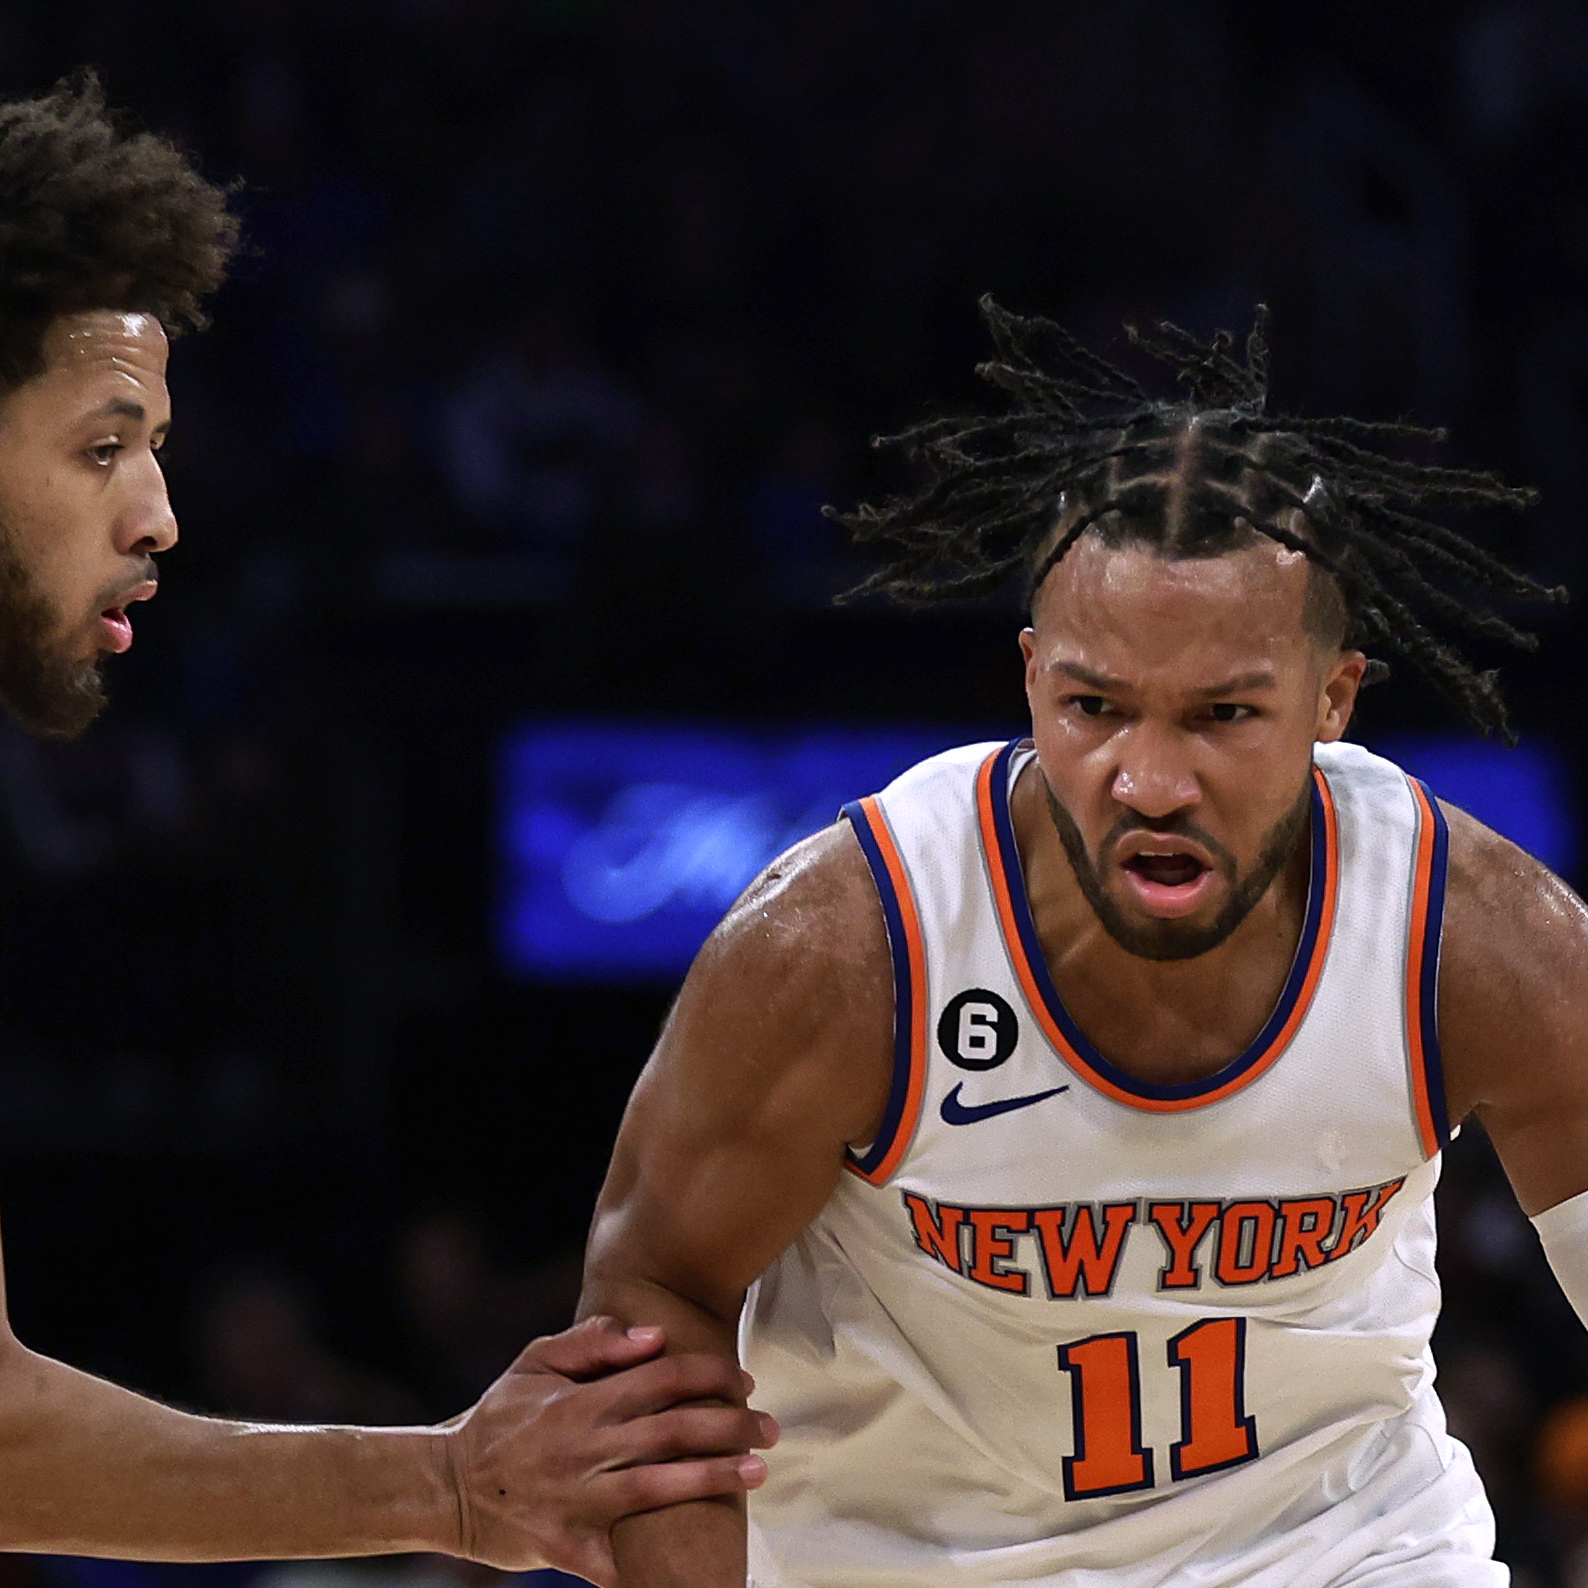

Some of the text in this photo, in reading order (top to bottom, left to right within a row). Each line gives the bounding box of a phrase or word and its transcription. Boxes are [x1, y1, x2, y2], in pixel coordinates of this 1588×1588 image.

[956, 1002, 1000, 1061] 6
[901, 1175, 1408, 1300] NEW YORK
[1056, 1316, 1260, 1502] 11
